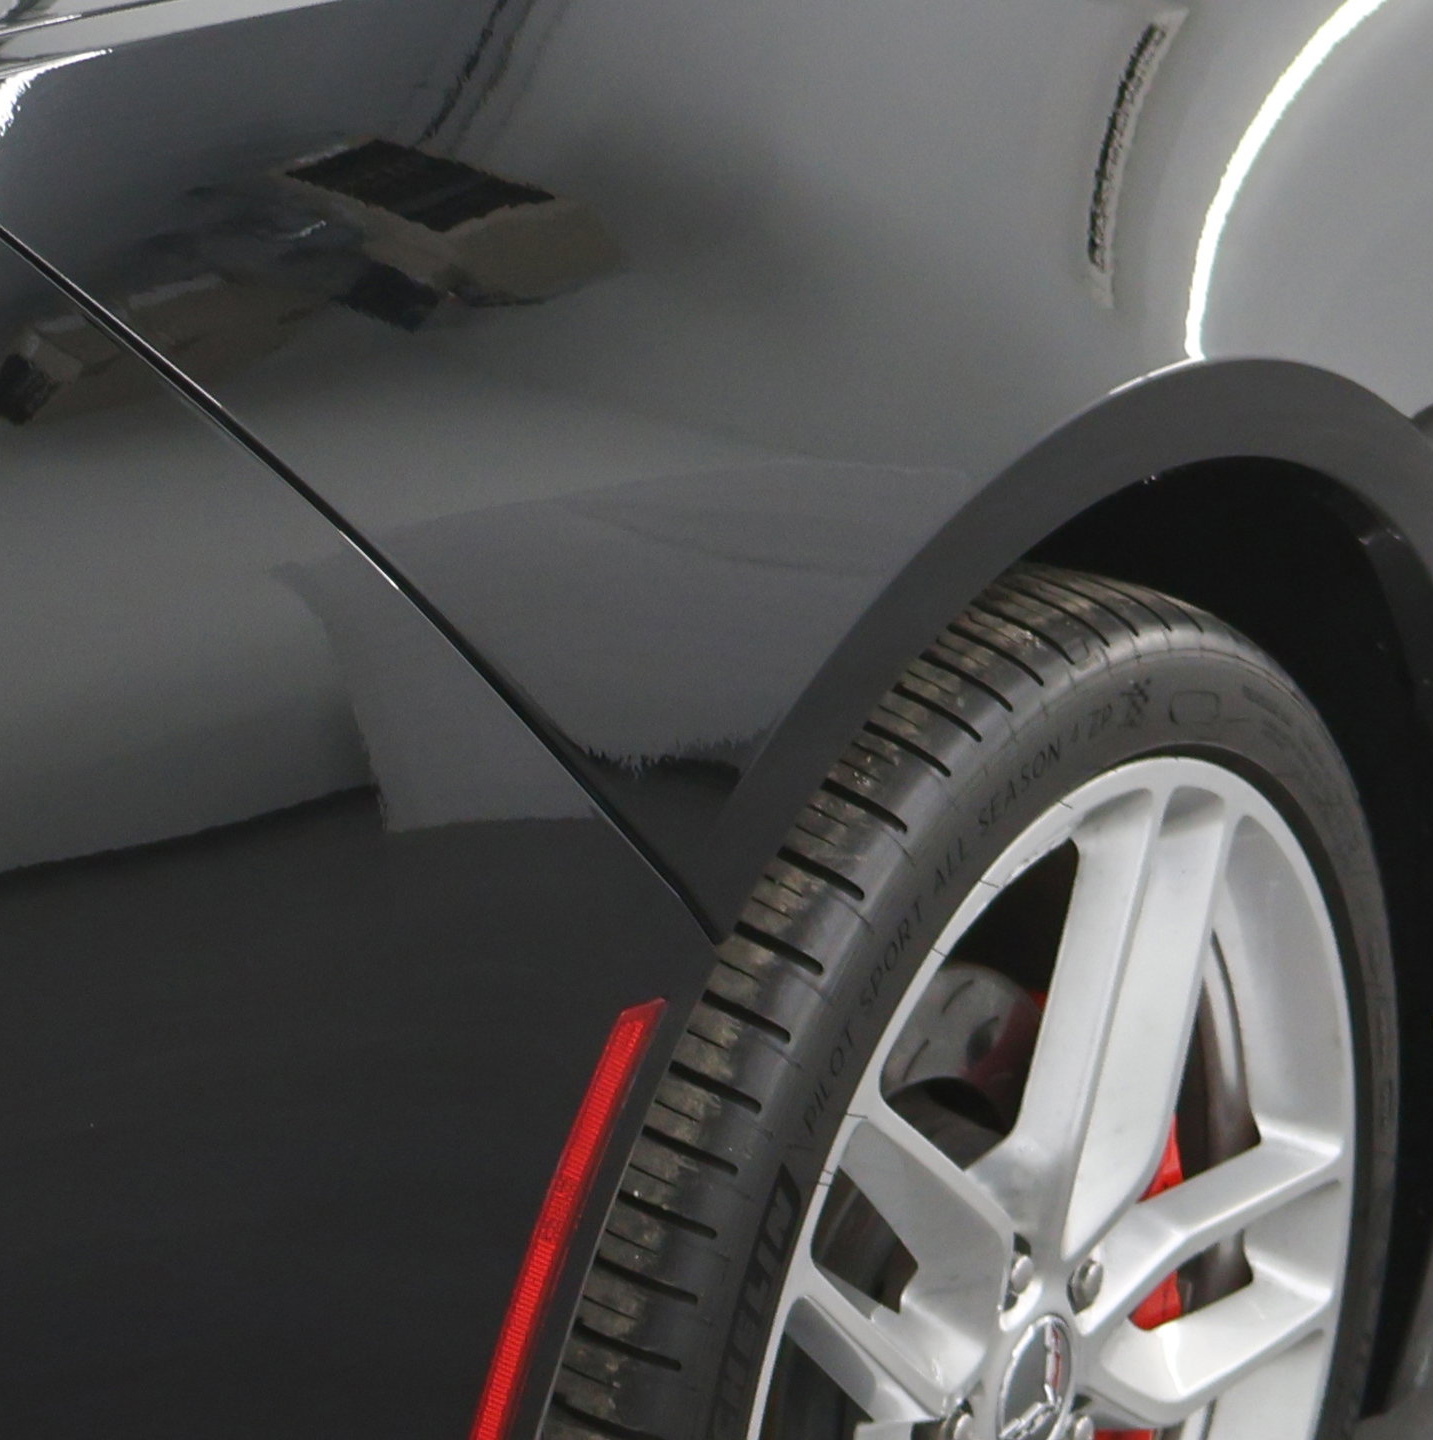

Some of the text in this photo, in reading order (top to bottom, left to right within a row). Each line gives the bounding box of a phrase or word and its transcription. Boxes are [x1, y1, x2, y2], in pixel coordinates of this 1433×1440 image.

[799, 1026, 856, 1137] PILOT
[857, 899, 926, 1009] SPORT
[931, 836, 968, 896] ALL
[976, 737, 1063, 832] SEASON
